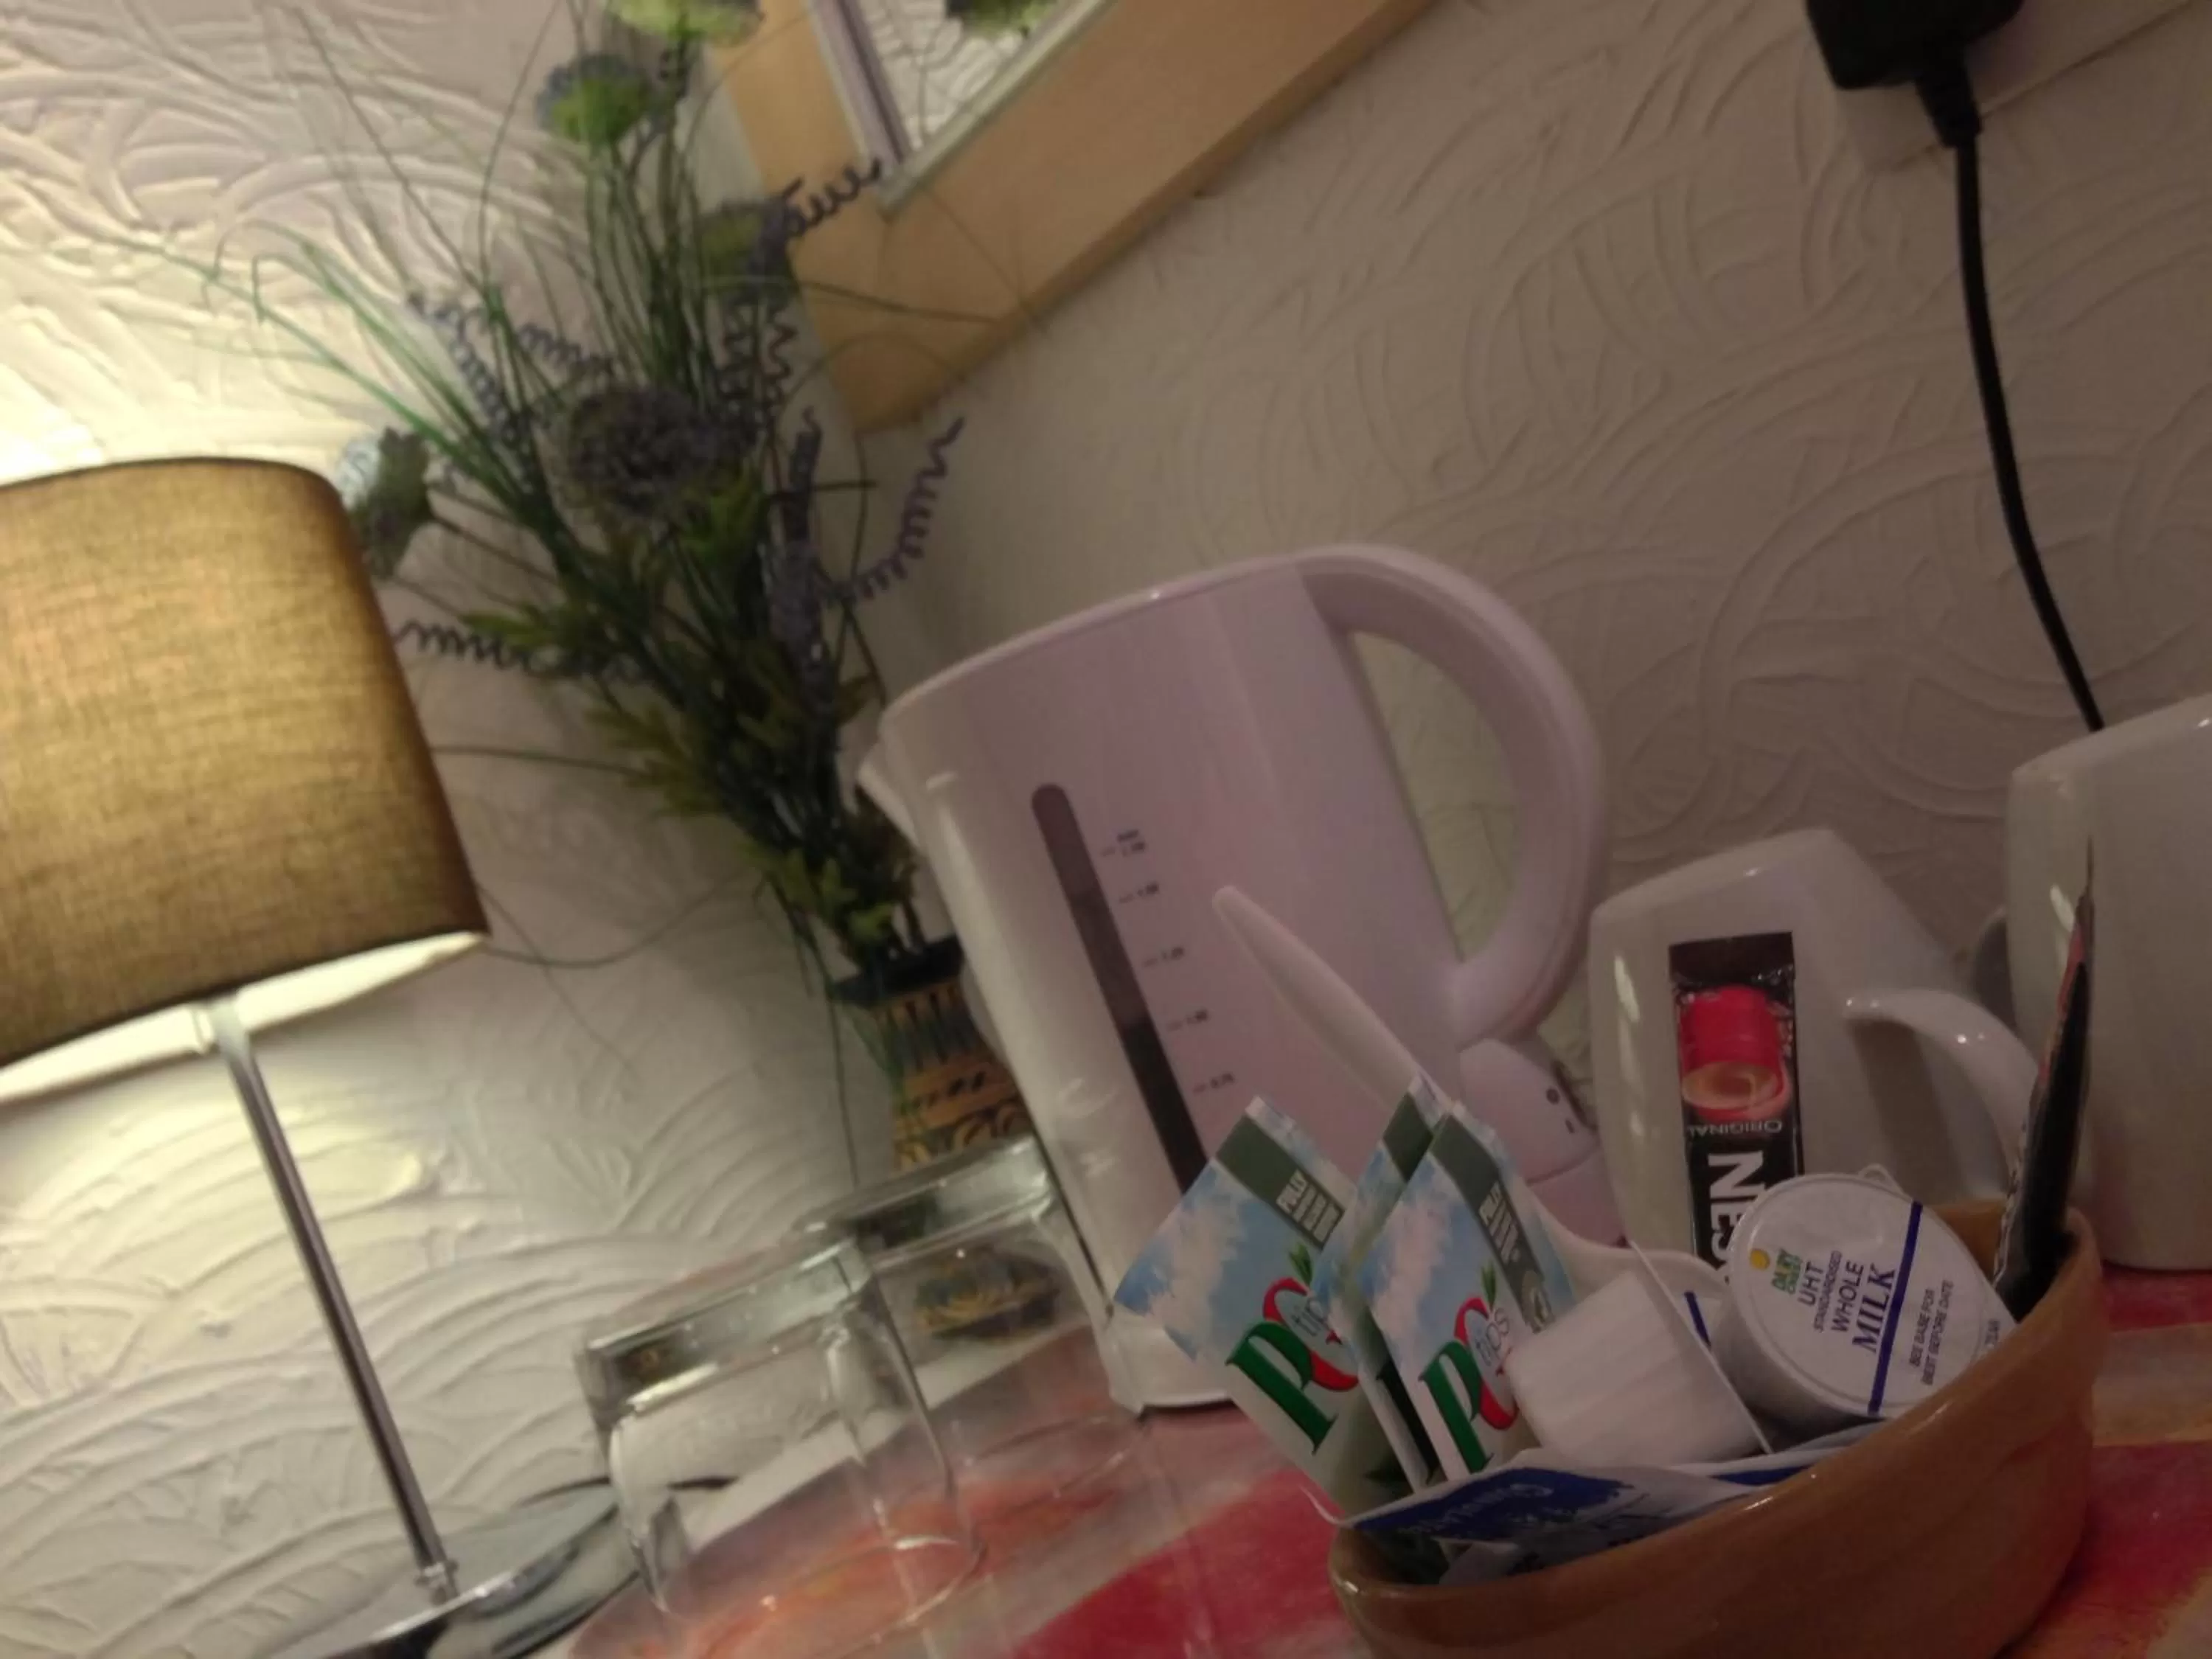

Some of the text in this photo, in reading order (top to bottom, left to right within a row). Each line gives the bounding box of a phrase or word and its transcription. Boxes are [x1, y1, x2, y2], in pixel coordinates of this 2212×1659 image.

[1797, 1260, 1824, 1307] UHT
[1830, 1259, 1865, 1332] WHOLE
[1851, 1262, 1896, 1354] MILK
